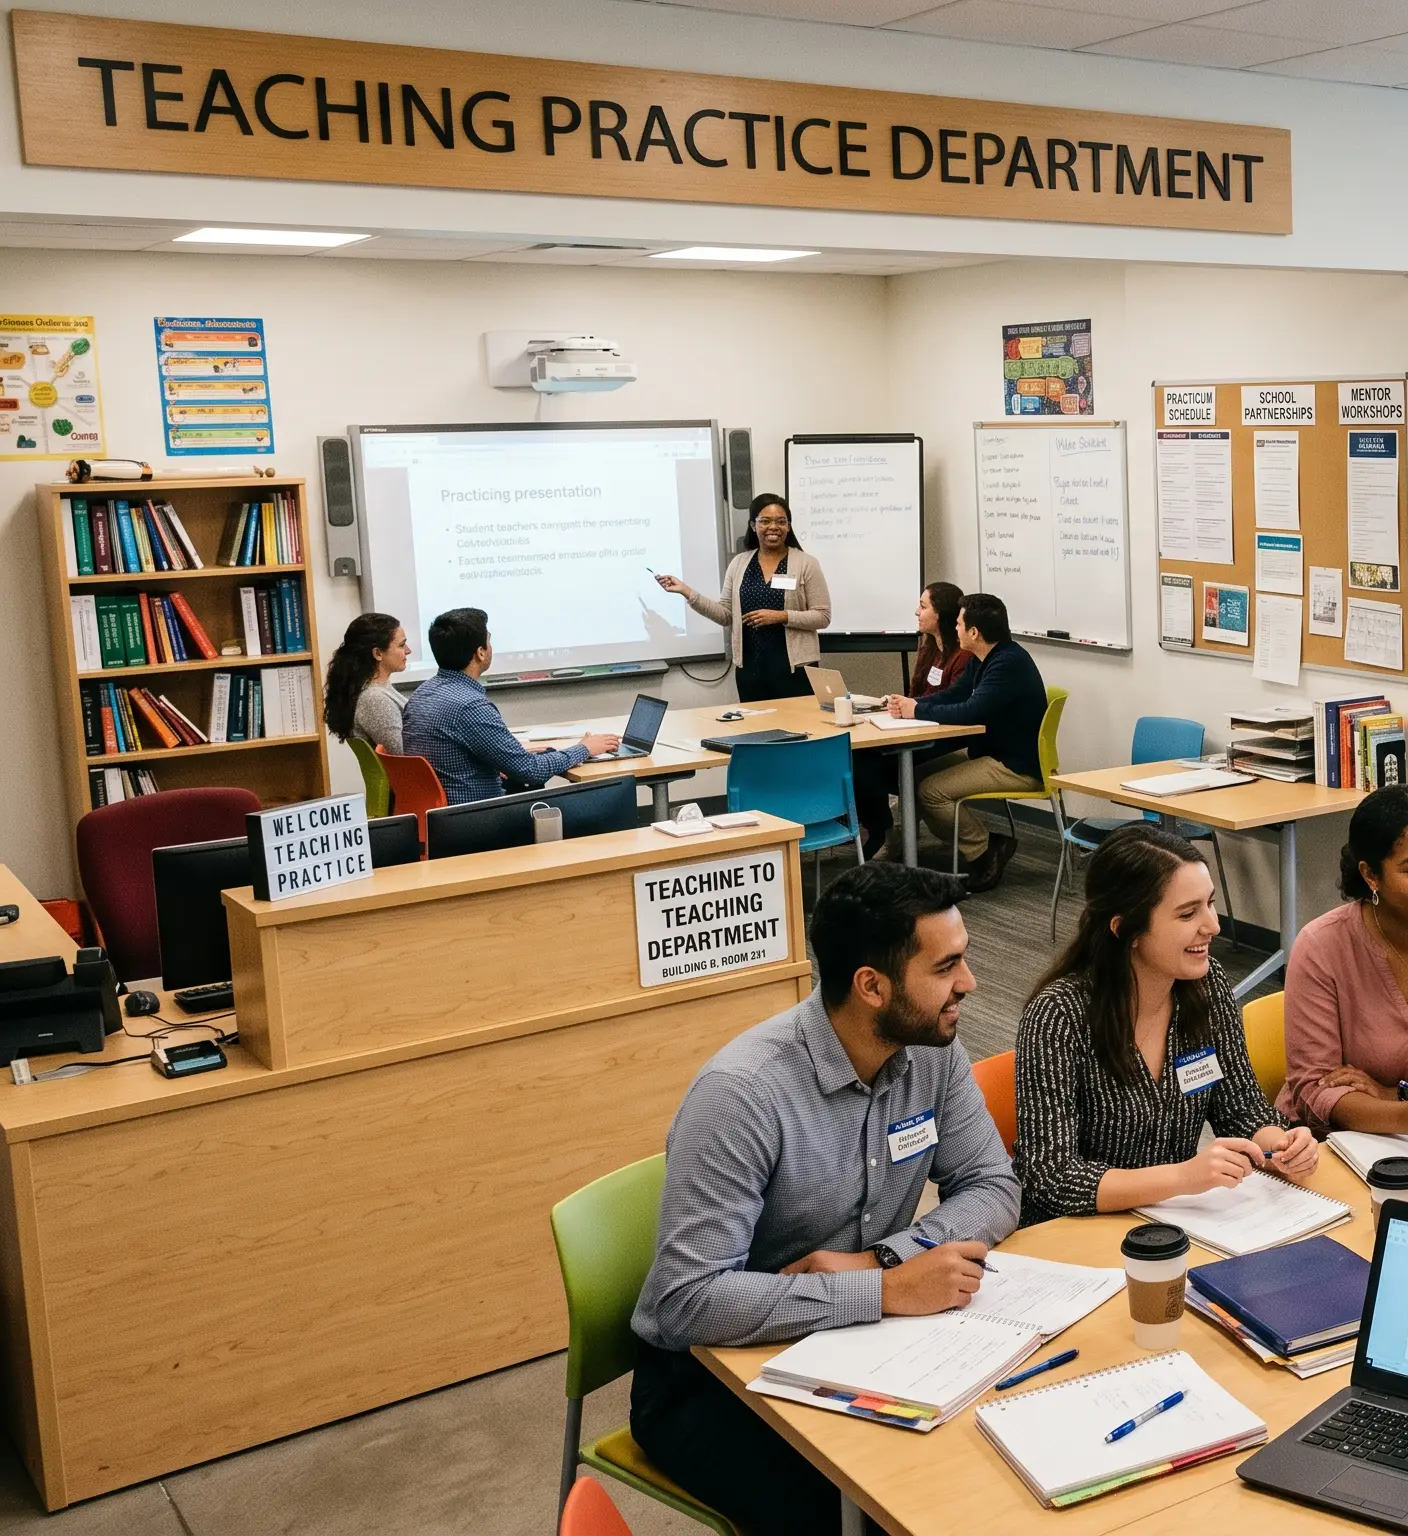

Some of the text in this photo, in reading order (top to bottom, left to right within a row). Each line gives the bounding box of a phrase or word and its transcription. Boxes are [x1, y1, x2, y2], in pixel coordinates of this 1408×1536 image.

[77, 56, 1265, 204] TEACHING PRACTICE DEPARTMENT
[1166, 392, 1213, 405] PRACTICUM
[1259, 391, 1297, 404] SCHOOL
[1351, 387, 1391, 401] MENTOR
[1168, 408, 1211, 421] SCHEDULE
[1244, 406, 1313, 420] PARTNERSHIPS
[1341, 404, 1403, 419] WORKSHOPS
[441, 485, 602, 503] Practicing presentation
[455, 523, 494, 534] Student
[497, 521, 538, 532] teachers
[272, 803, 352, 837] WELCOME
[274, 827, 363, 865] TEACHING
[277, 853, 366, 892] PRACTICE
[645, 861, 775, 902] TEACHINE TO
[661, 892, 763, 929] TEACHING
[647, 917, 780, 961] DEPARTMENT
[662, 960, 708, 978] BUILDING
[721, 952, 749, 967] ROOM
